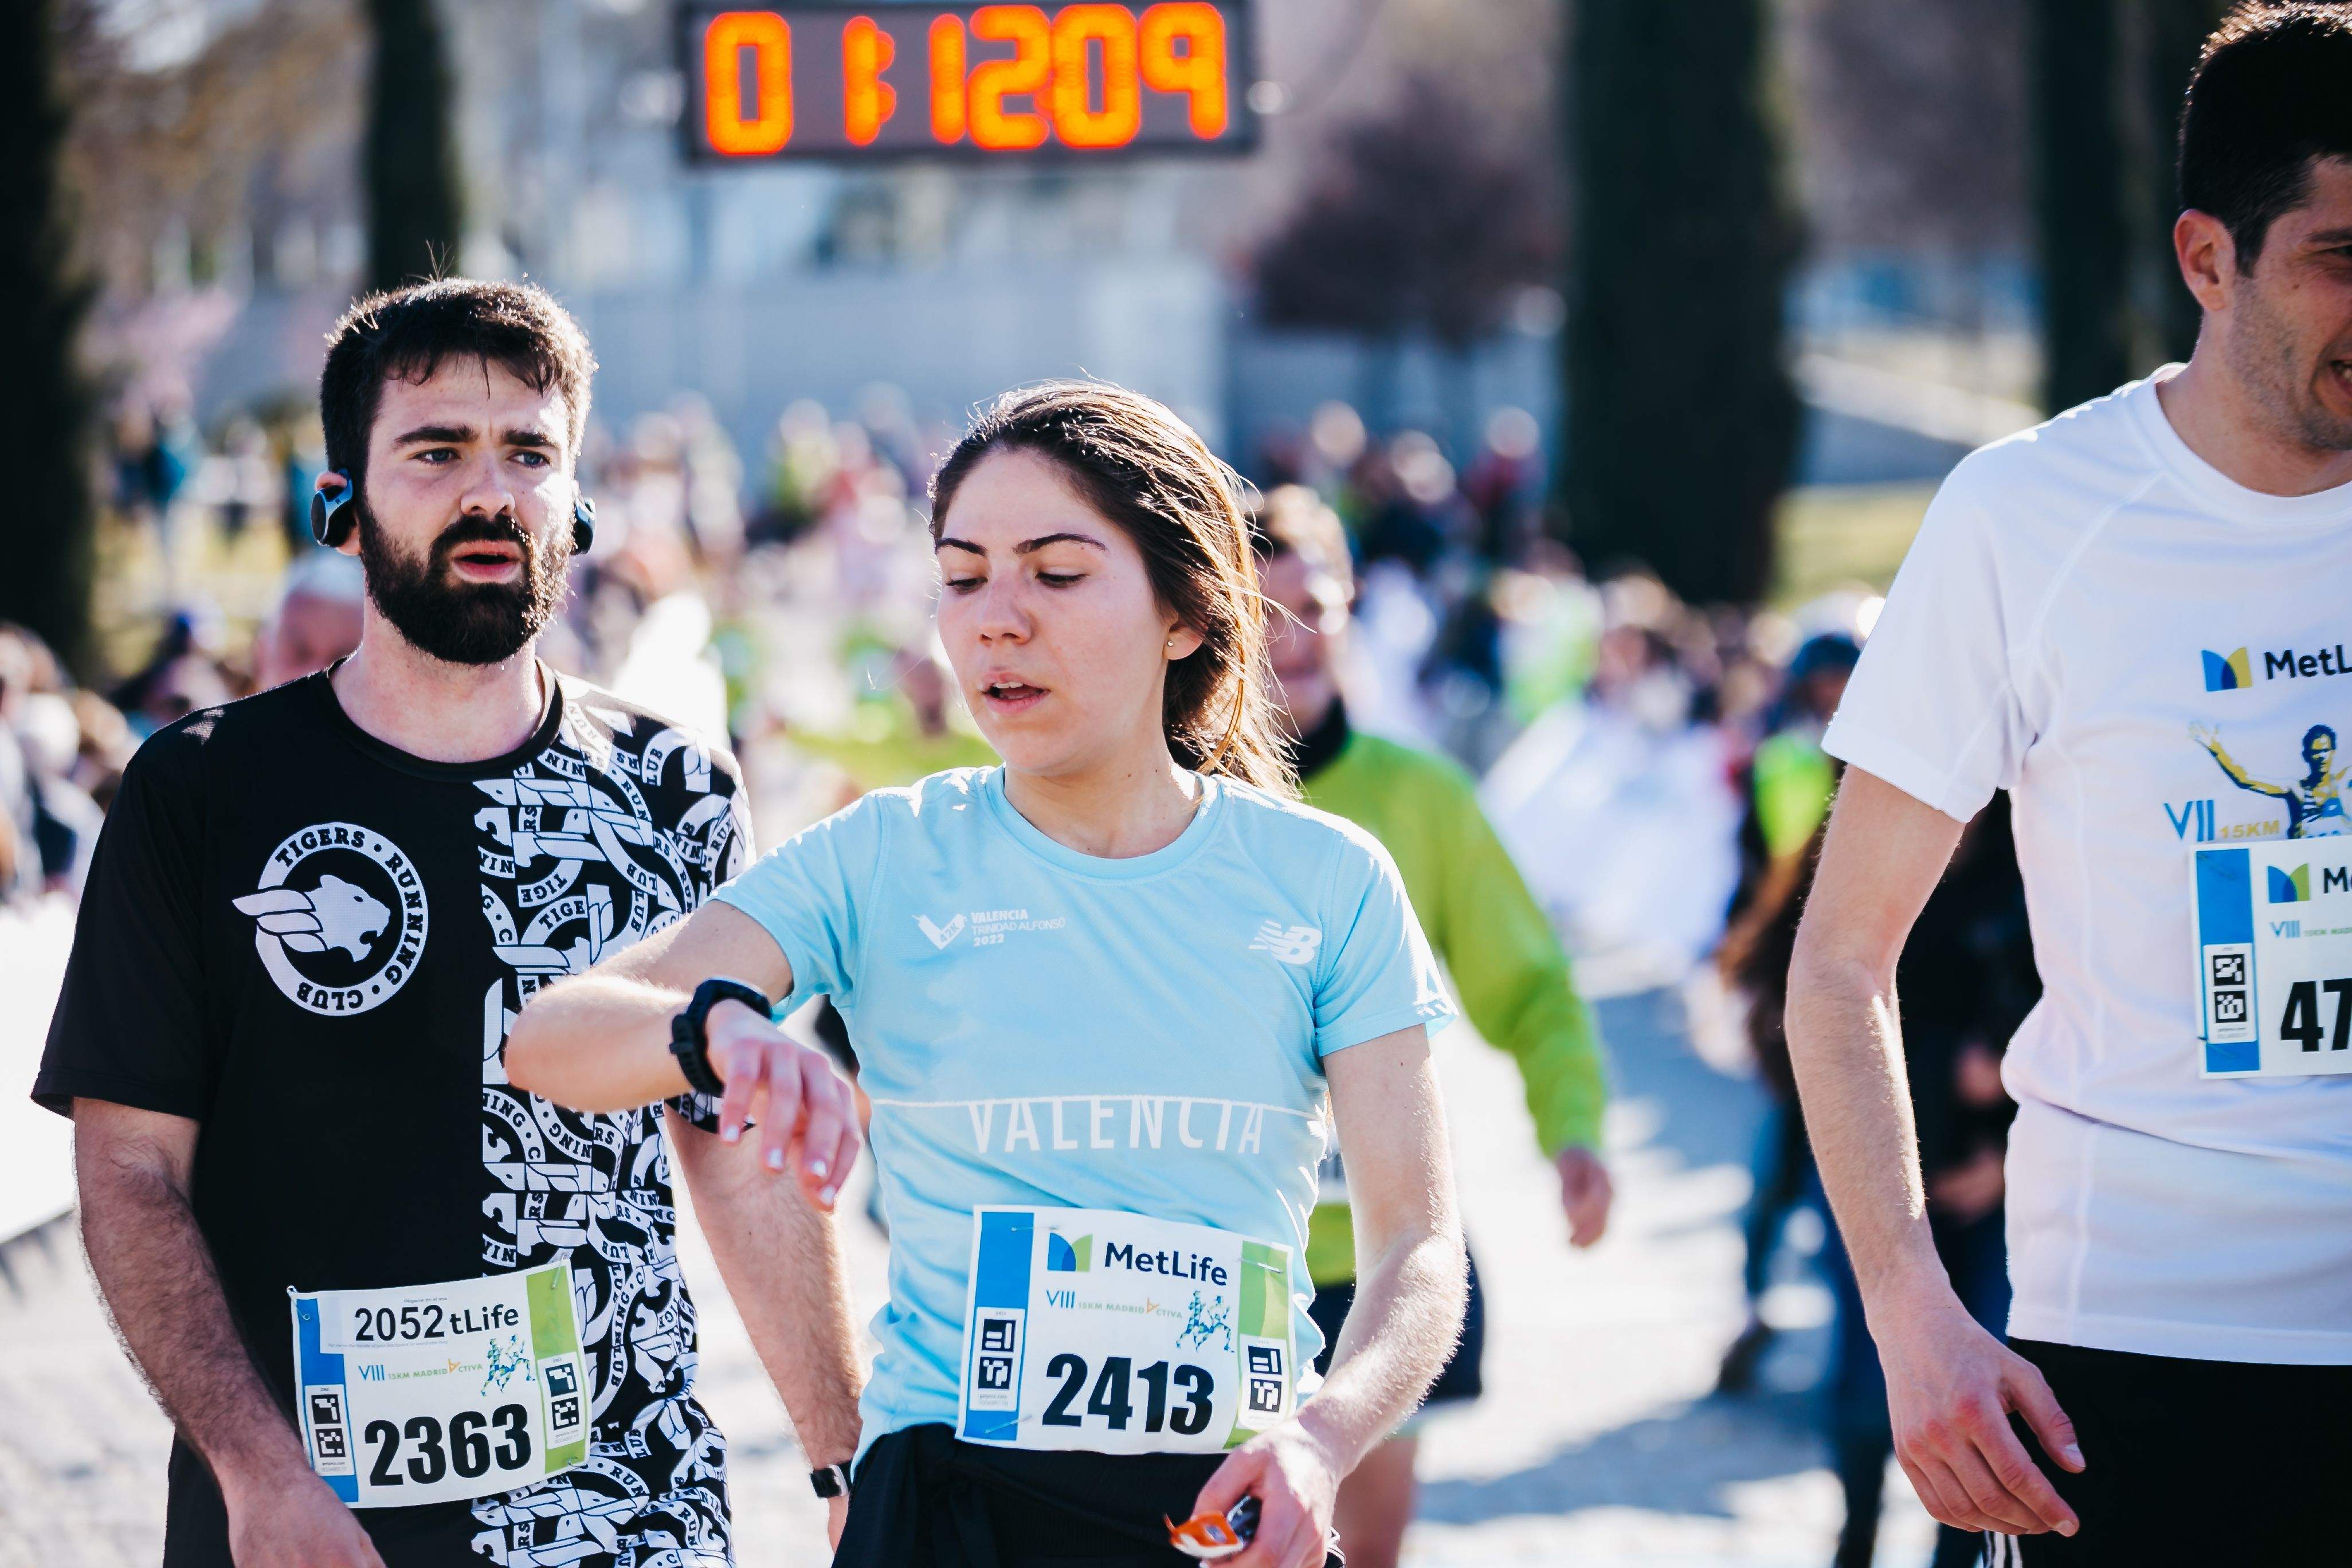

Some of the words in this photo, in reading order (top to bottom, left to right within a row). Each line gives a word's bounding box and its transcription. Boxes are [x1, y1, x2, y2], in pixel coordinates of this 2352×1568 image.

[2220, 820, 2280, 839] 15KM
[275, 827, 366, 867] TIGERS
[385, 852, 424, 986] RUNNING
[971, 909, 1029, 923] VALENCIA
[971, 922, 1017, 935] TRINIDAD
[1018, 917, 1066, 931] ALFONSO
[974, 934, 1005, 947] 2022
[296, 982, 363, 1011] CLUB
[969, 1098, 1262, 1154] VALENCIA
[1104, 1242, 1228, 1286] MetLife
[1046, 1289, 1076, 1309] VIII
[1078, 1302, 1103, 1311] 15KM
[1106, 1303, 1145, 1315] MADRID
[355, 1304, 445, 1341] 2052
[358, 1364, 386, 1381] VIII
[388, 1371, 410, 1381] 15KM
[412, 1368, 448, 1378] MADRID
[1042, 1353, 1215, 1436] 2413
[364, 1404, 532, 1487] 2363
